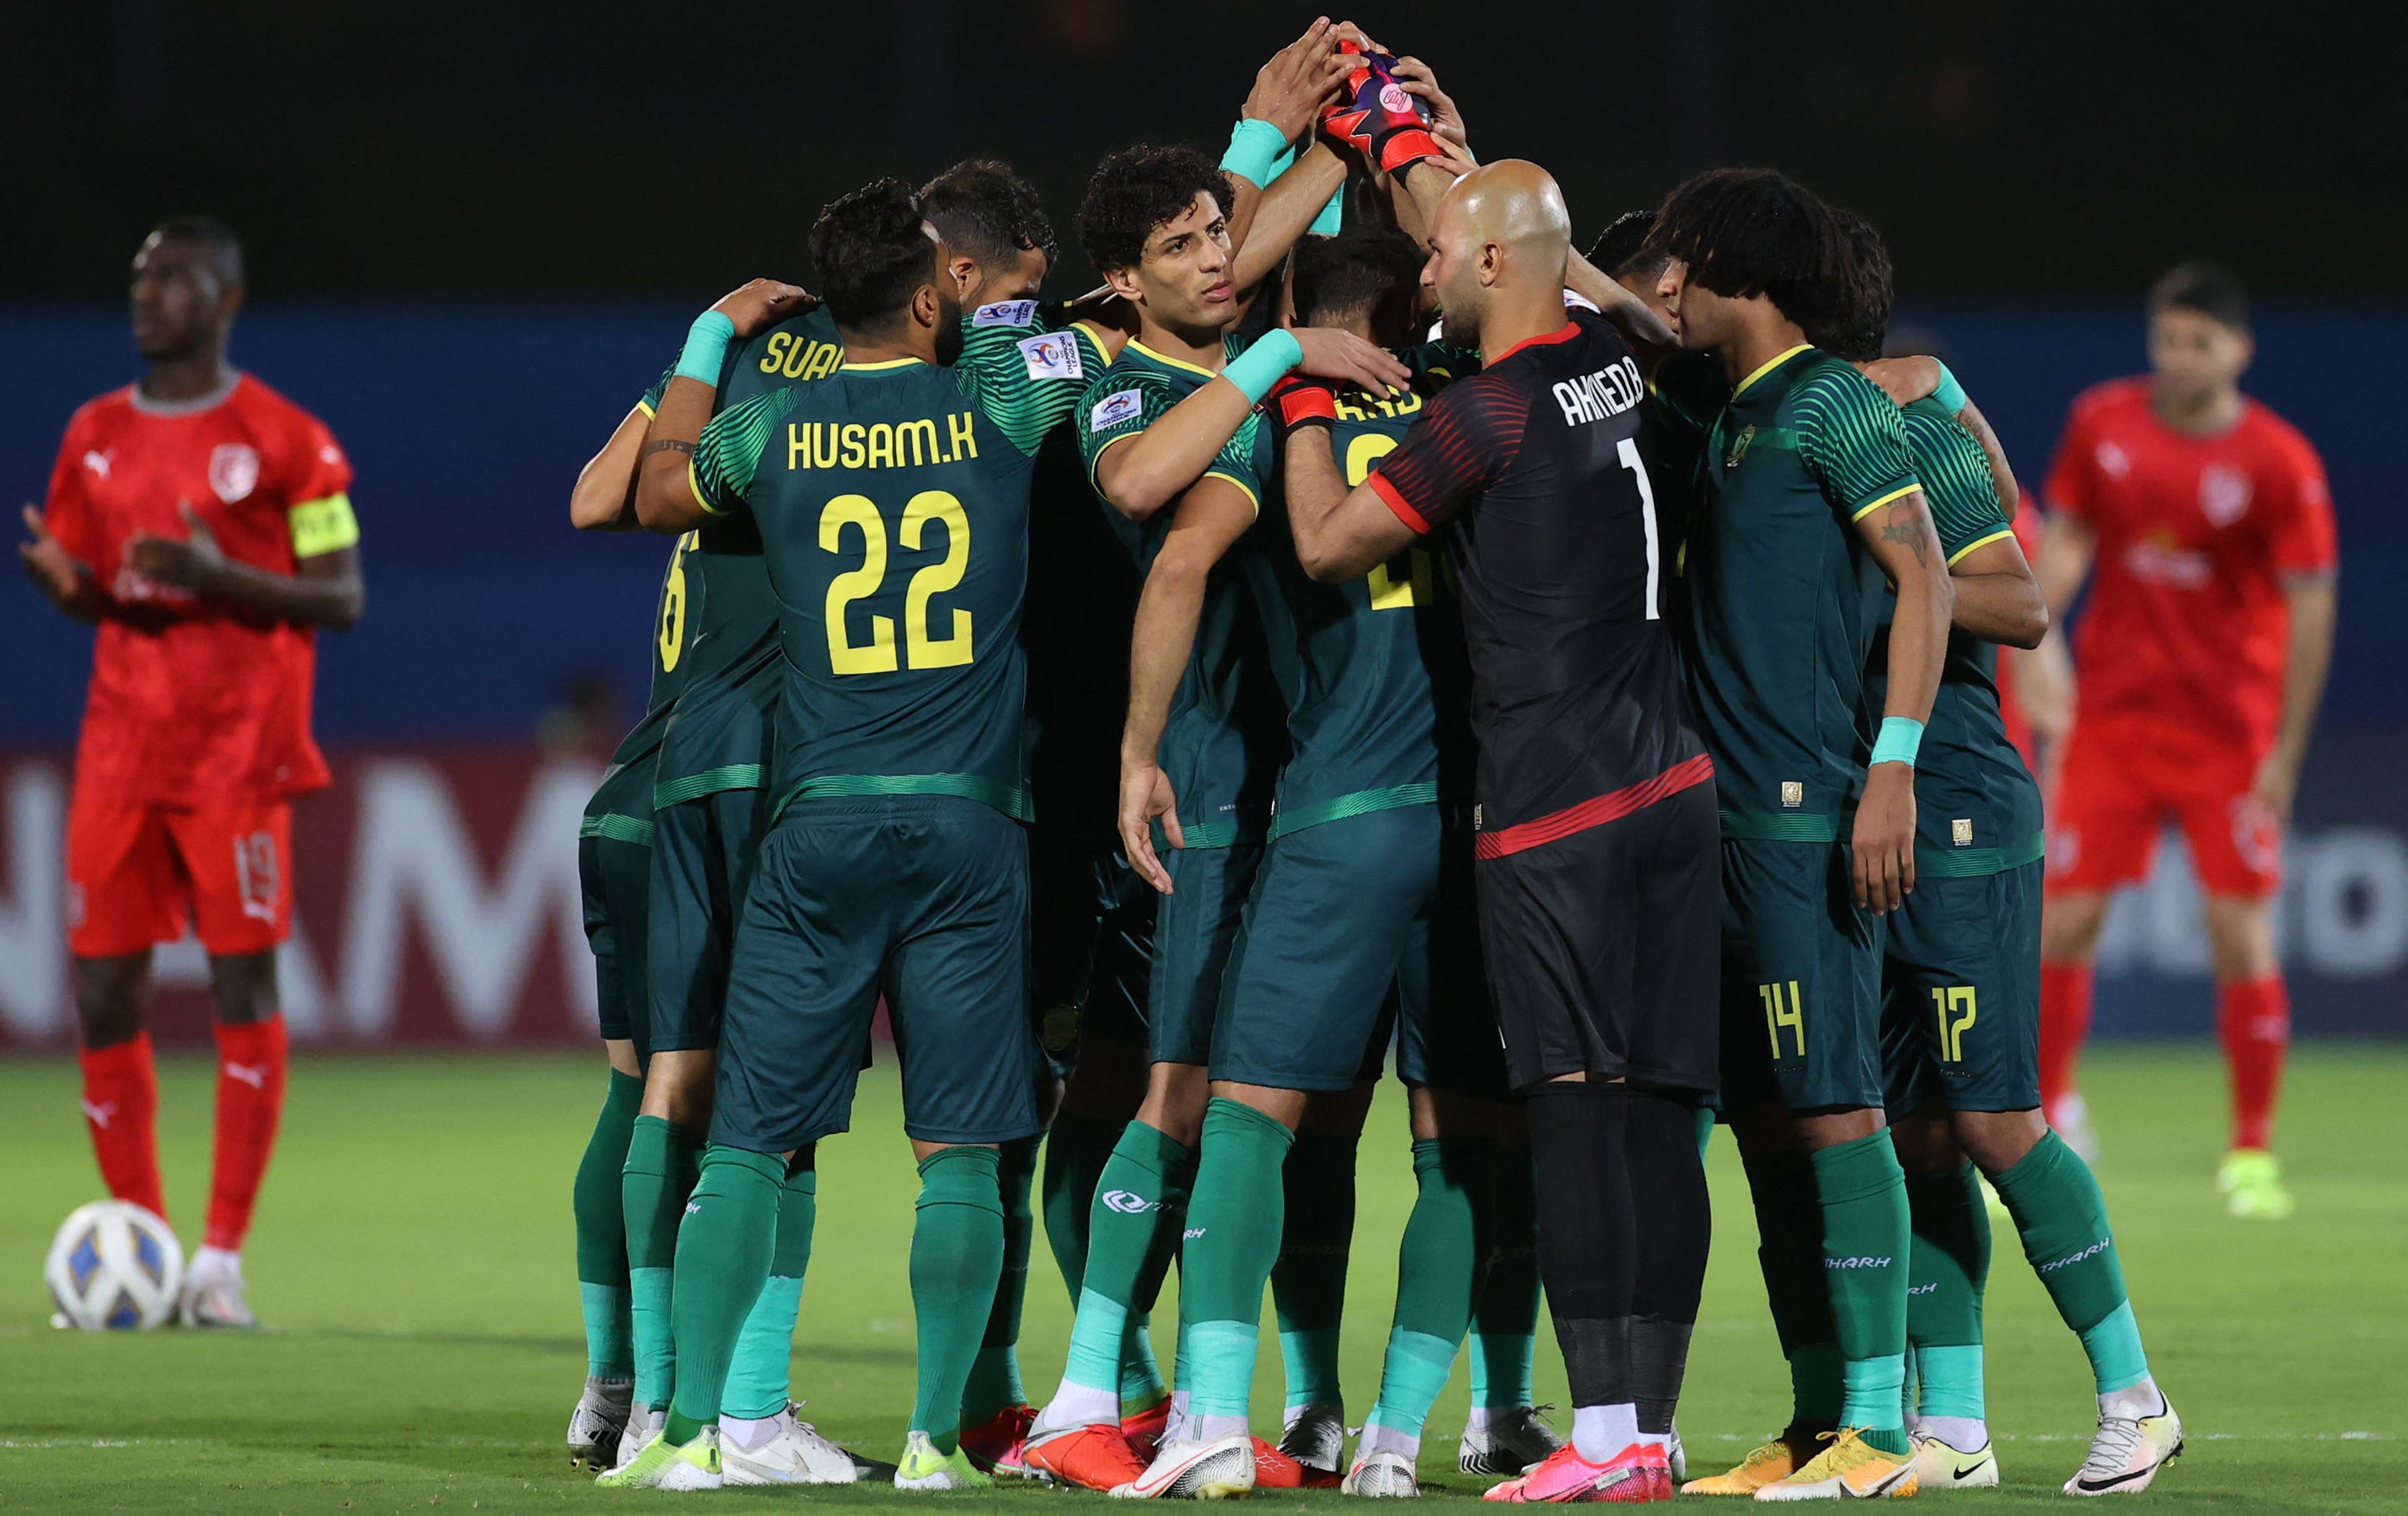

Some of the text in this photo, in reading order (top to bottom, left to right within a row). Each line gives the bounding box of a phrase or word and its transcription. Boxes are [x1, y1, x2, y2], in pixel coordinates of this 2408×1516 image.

[1058, 335, 1074, 375] CHAMPIONS
[1066, 339, 1078, 368] LEAGUE
[788, 411, 979, 471] HUSAM.K
[1616, 437, 1661, 621] 1
[818, 490, 975, 675] 22
[1759, 980, 1805, 1060] 14
[1931, 986, 1977, 1062] 17
